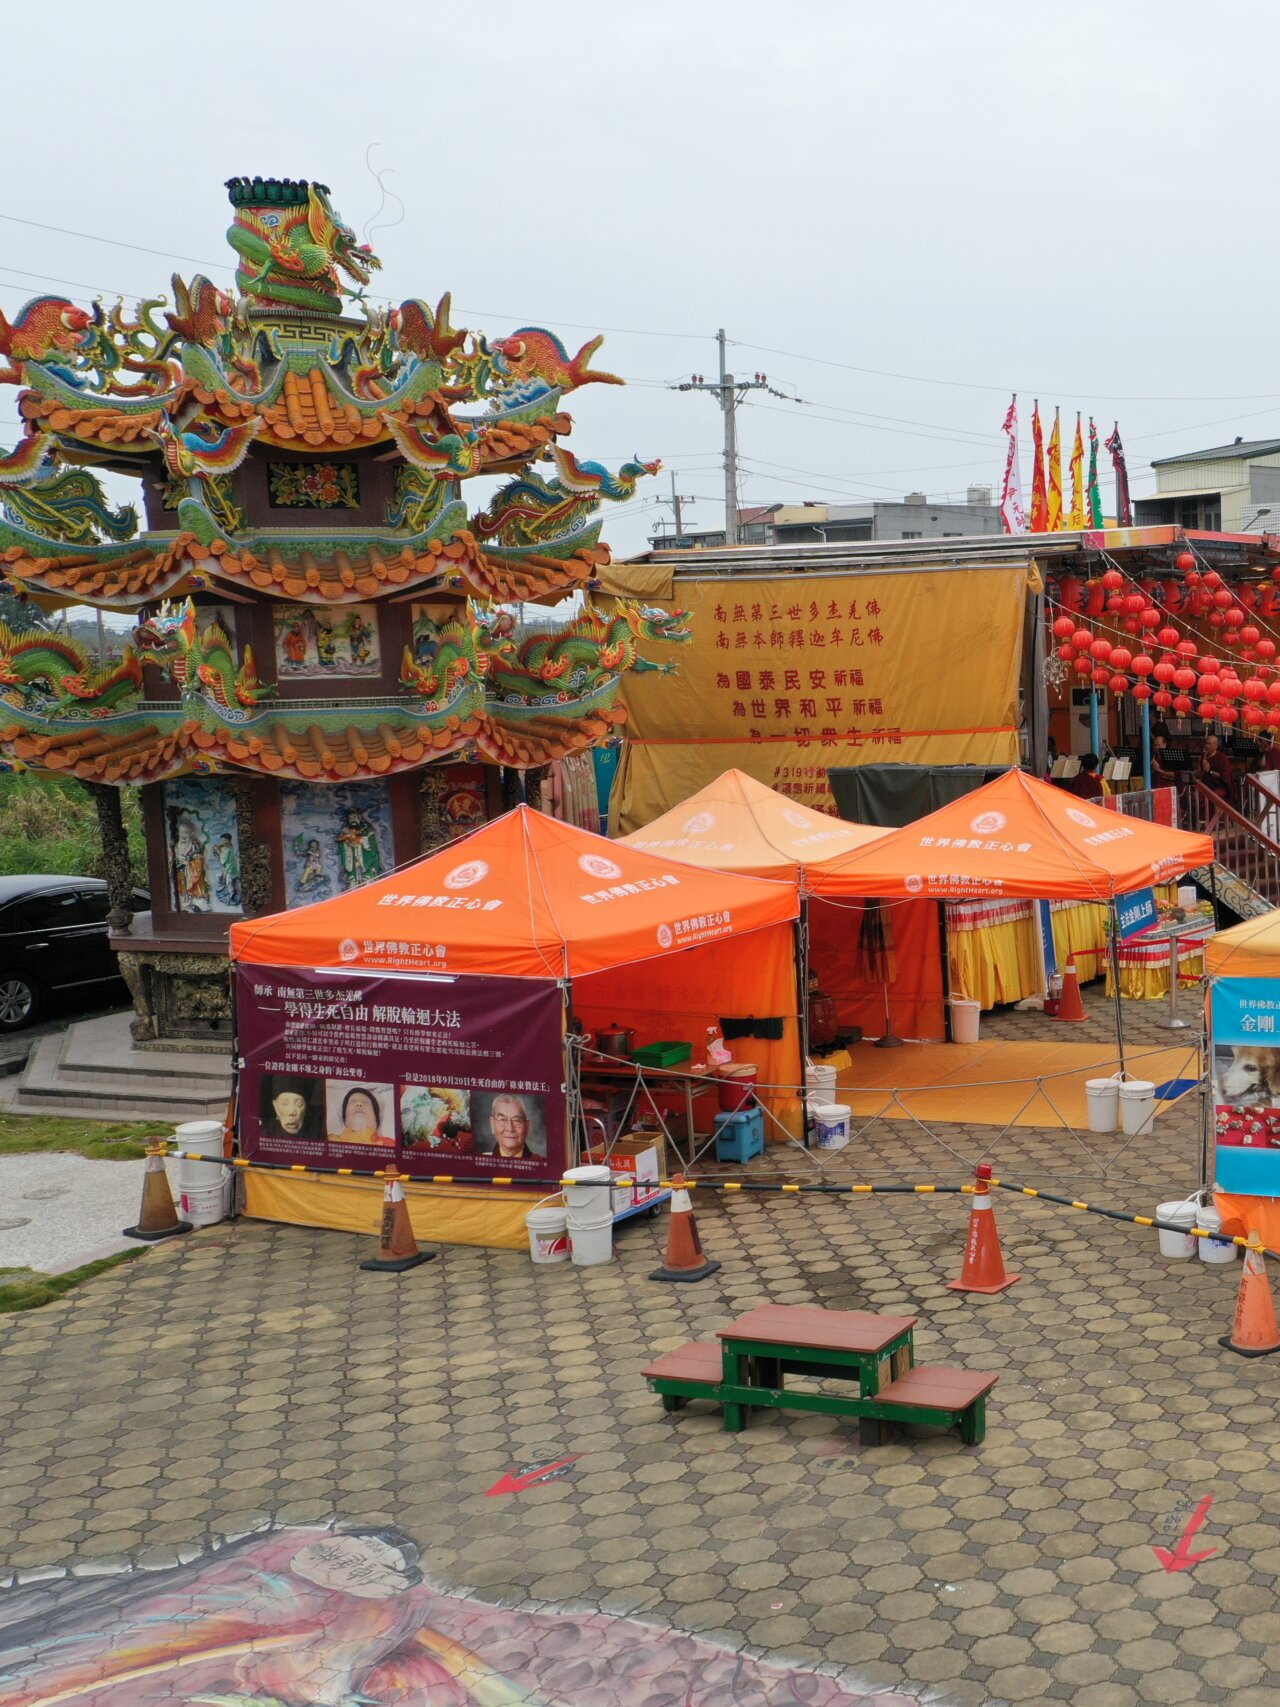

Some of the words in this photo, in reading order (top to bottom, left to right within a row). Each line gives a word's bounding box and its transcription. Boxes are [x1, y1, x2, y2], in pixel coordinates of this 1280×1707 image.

[714, 598, 882, 623] 南無第三世多杰羌佛
[716, 626, 884, 650] 南無本師釋迦牟尼佛
[717, 668, 864, 690] 為國泰民安祈福
[732, 698, 883, 718] 為世界和平祈福
[920, 836, 1033, 853] 世界佛教正心會
[579, 874, 682, 905] 世界佛教正心會
[927, 874, 1004, 887] 世界佛教正心會
[927, 886, 1004, 896] www.RightHeart.org
[378, 894, 504, 911] 世界佛教正心會
[673, 910, 732, 935] 世界佛教正心會
[676, 925, 733, 945] www.RightHeart.org
[362, 939, 447, 957] 世界佛教正心會
[363, 956, 447, 969] www.RightHeart.org
[254, 984, 273, 997] 師承
[372, 1005, 461, 1028] 解脫輪迴大法
